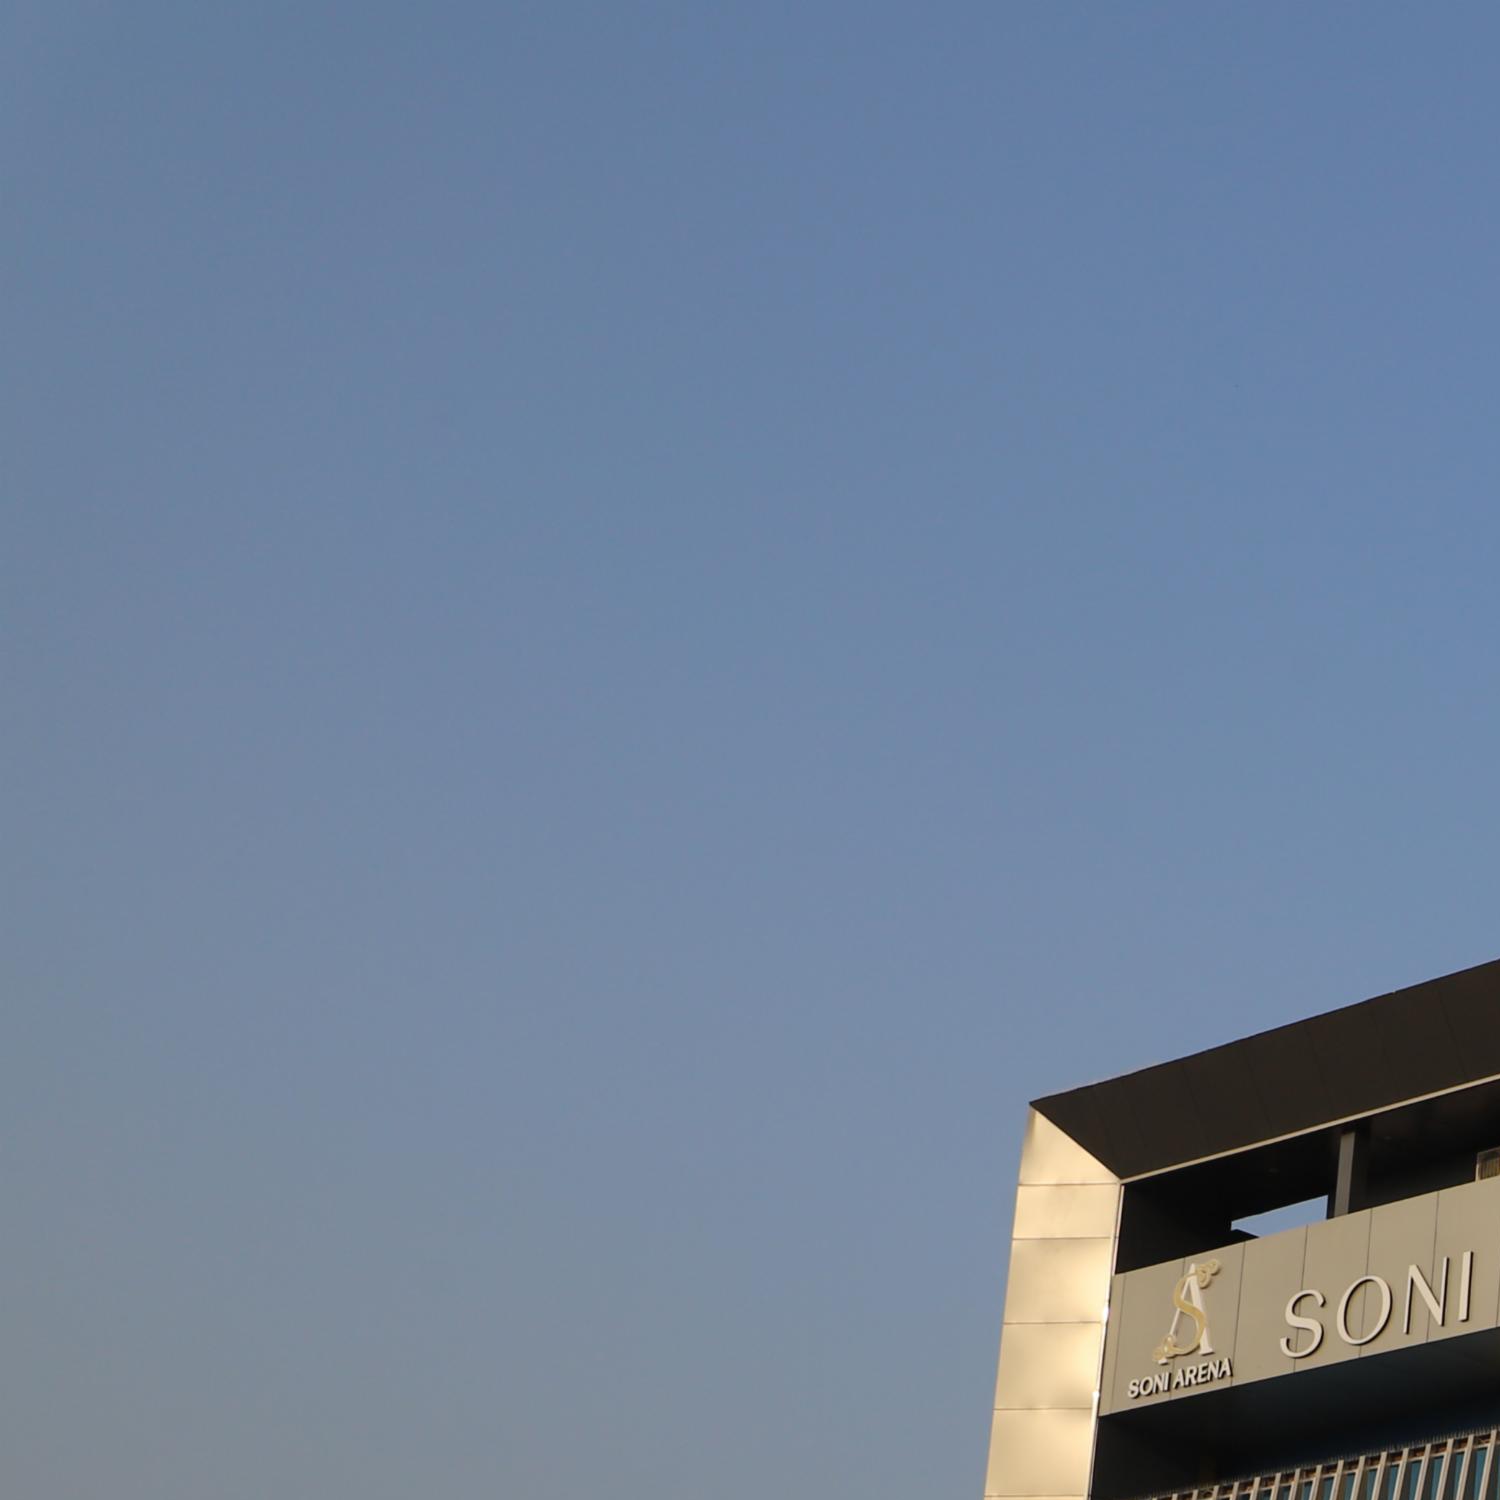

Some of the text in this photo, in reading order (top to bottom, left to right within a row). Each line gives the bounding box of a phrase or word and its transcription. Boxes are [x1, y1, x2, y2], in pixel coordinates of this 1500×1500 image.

[1281, 1250, 1475, 1359] SONI
[1127, 1357, 1232, 1399] SONI ARENA
